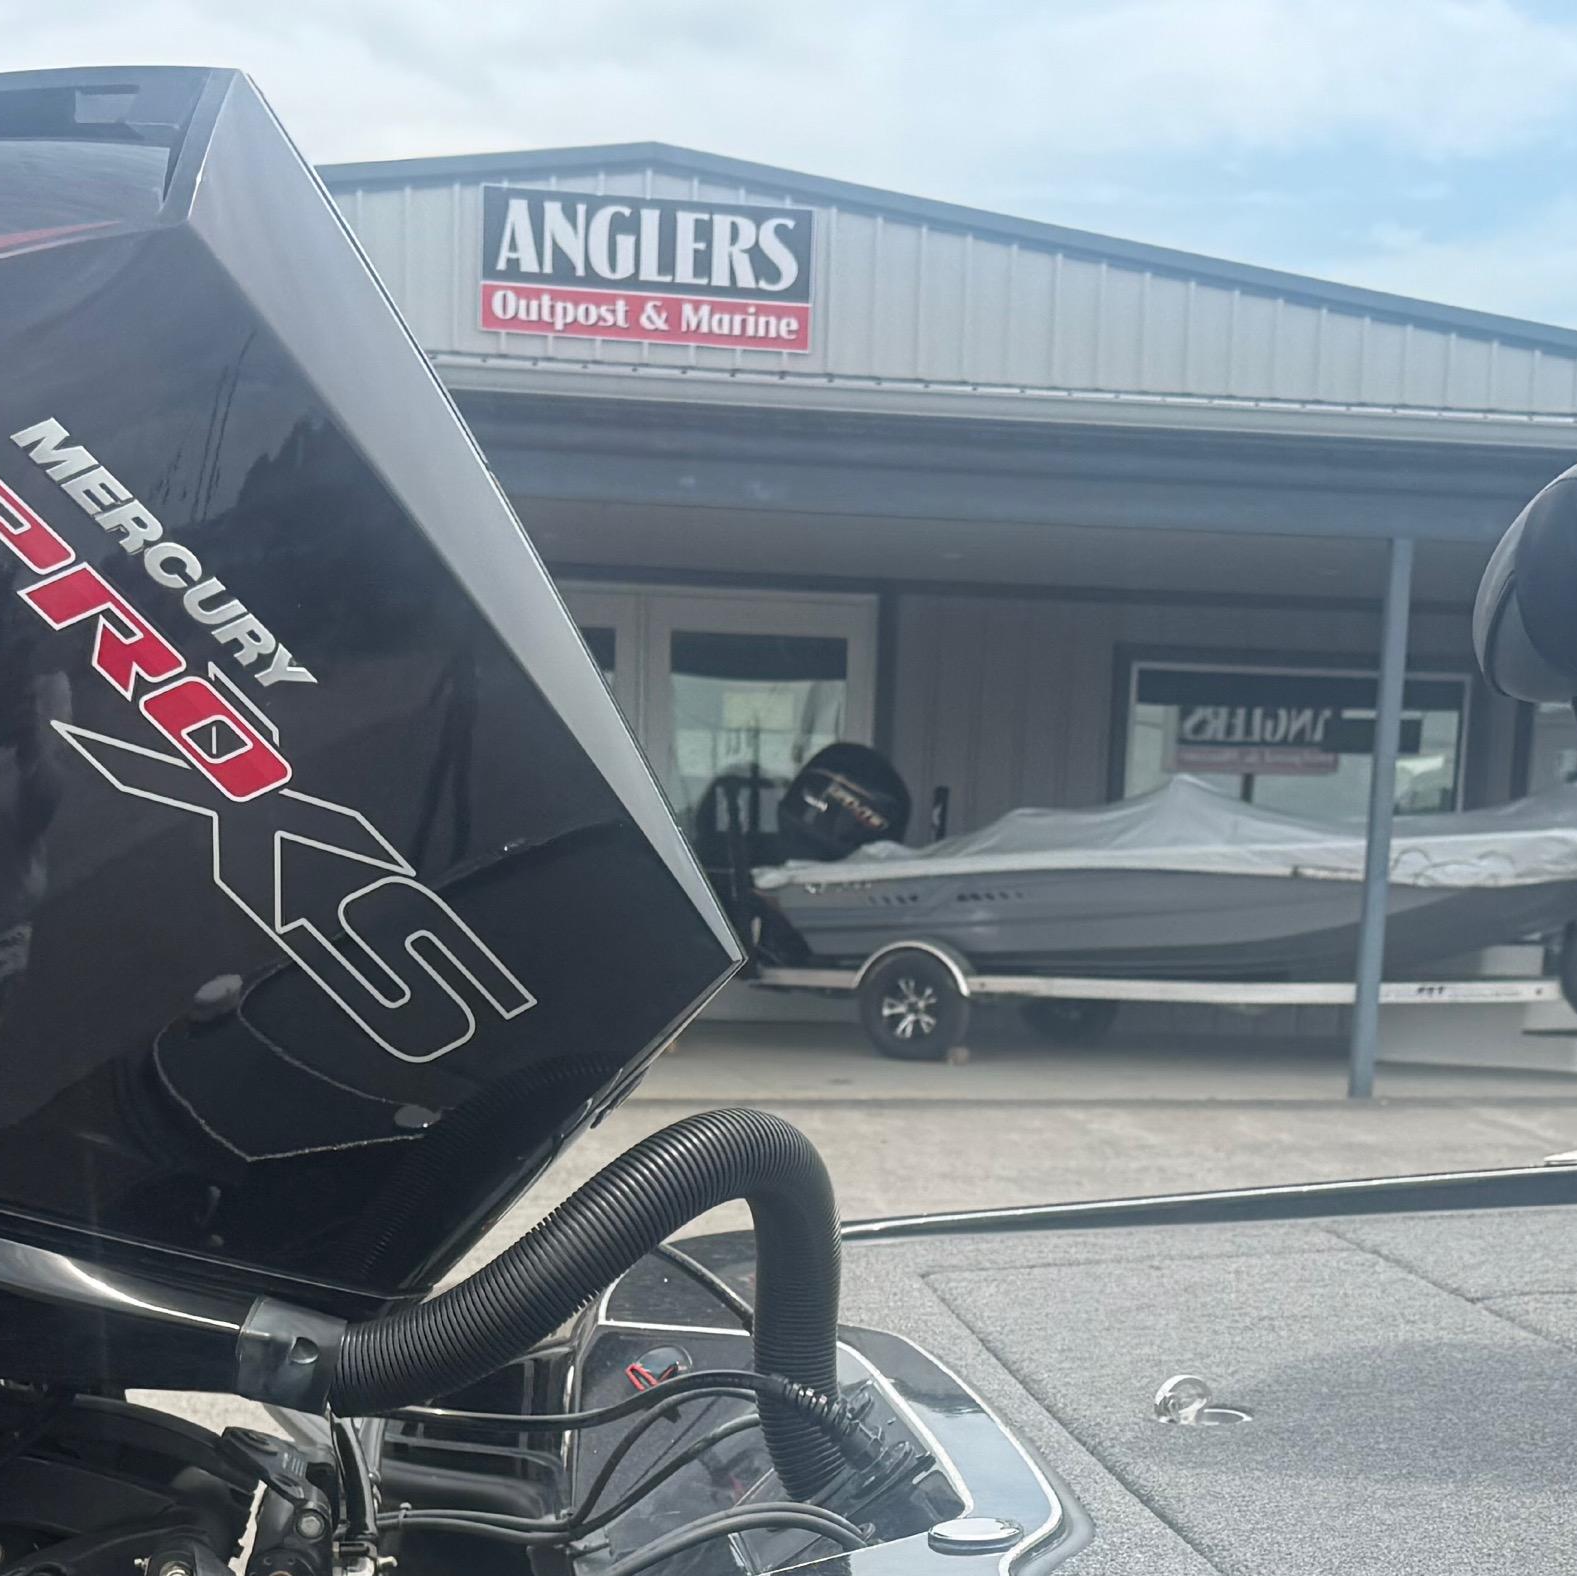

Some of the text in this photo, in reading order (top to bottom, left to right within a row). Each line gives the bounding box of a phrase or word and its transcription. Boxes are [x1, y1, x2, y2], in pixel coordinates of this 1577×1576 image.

[491, 289, 799, 340] Outpost & Marine
[495, 198, 799, 291] ANGLERS
[10, 417, 318, 688] MERCURY
[50, 660, 538, 1063] XS
